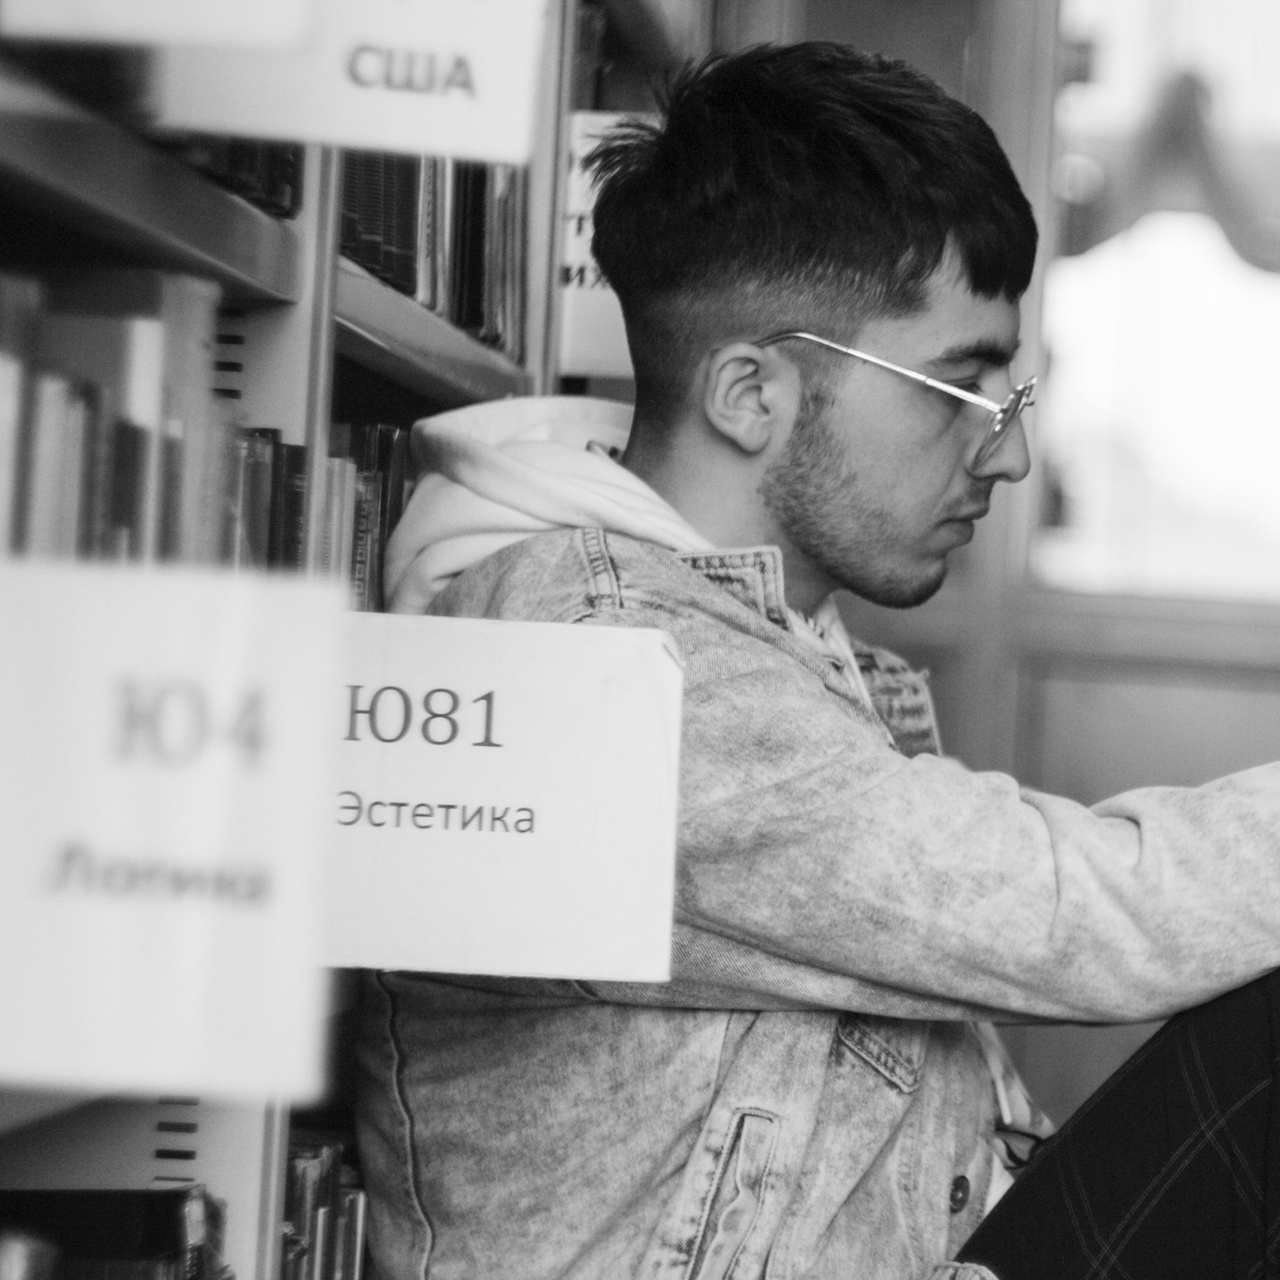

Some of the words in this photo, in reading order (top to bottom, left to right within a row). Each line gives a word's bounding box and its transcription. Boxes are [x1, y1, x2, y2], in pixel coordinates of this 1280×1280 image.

[346, 43, 477, 100] США
[341, 683, 504, 748] Ю81
[336, 789, 535, 835] Эстетика
